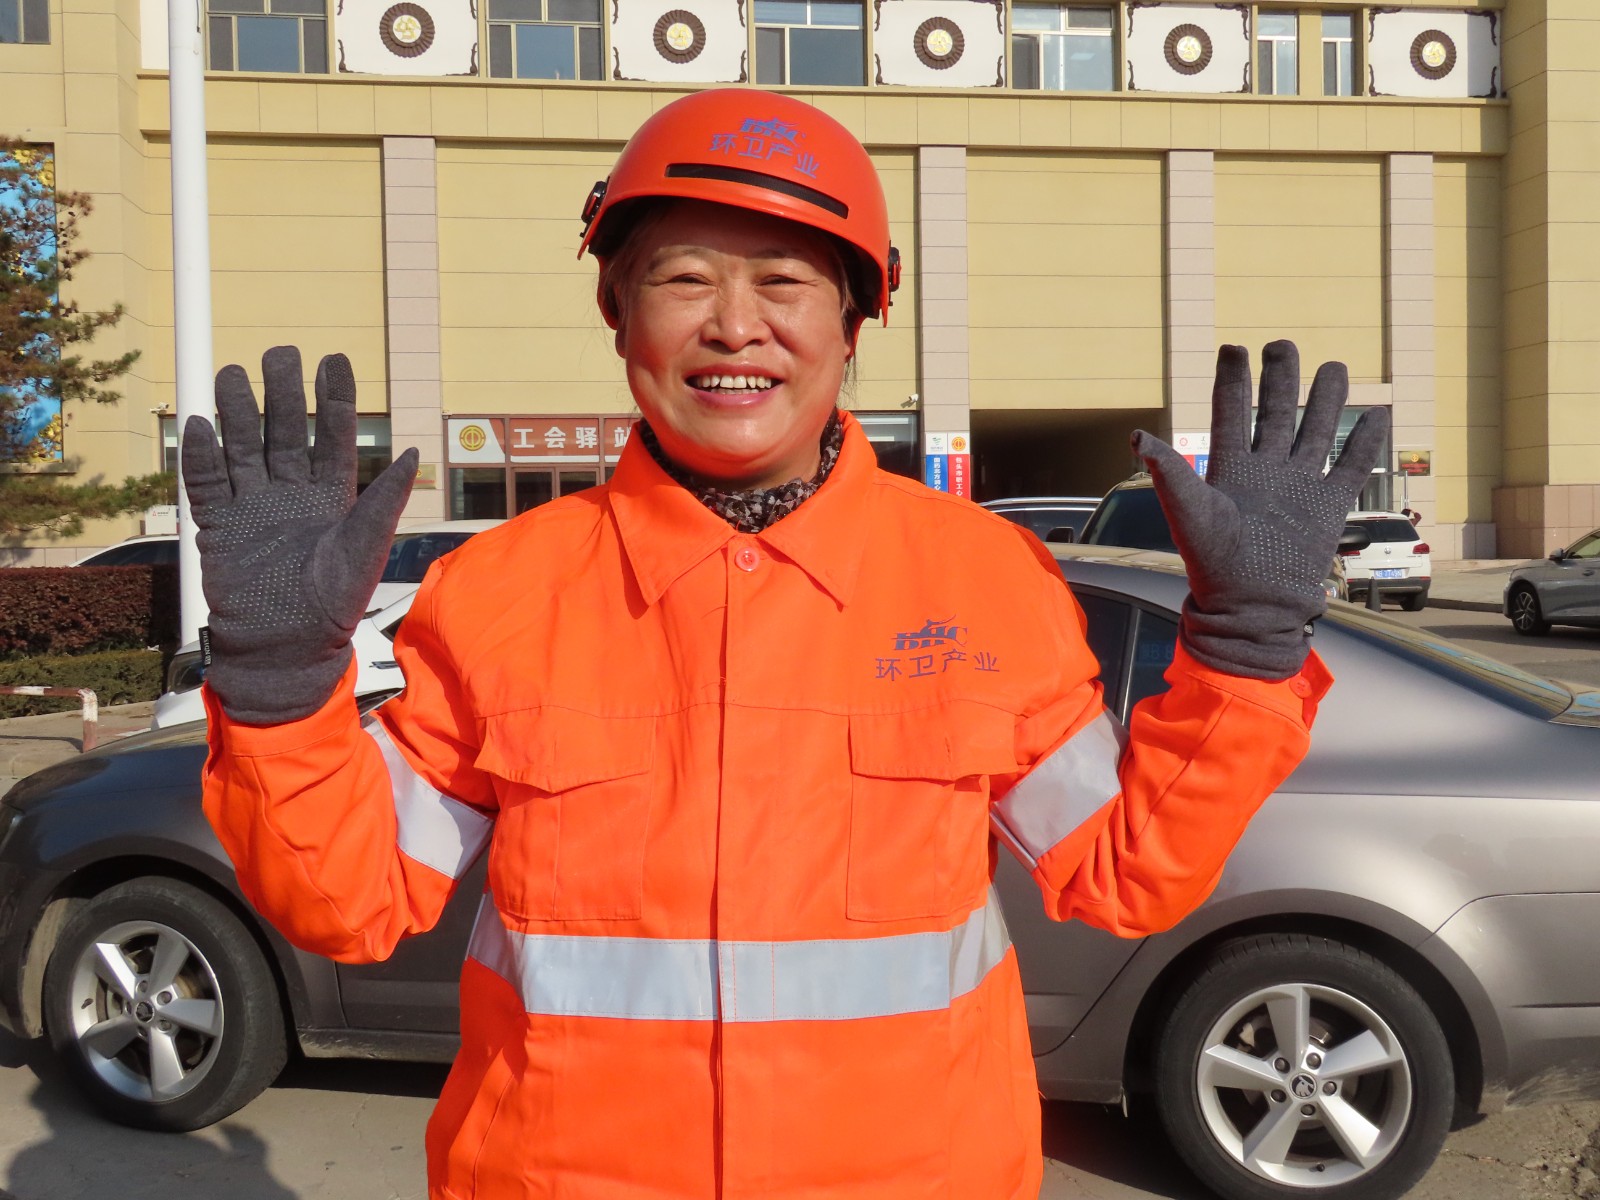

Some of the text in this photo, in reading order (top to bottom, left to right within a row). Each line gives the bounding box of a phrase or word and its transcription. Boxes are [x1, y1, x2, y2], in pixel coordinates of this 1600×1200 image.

[709, 133, 820, 179] 环卫产业
[875, 648, 1000, 681] 环卫产业
